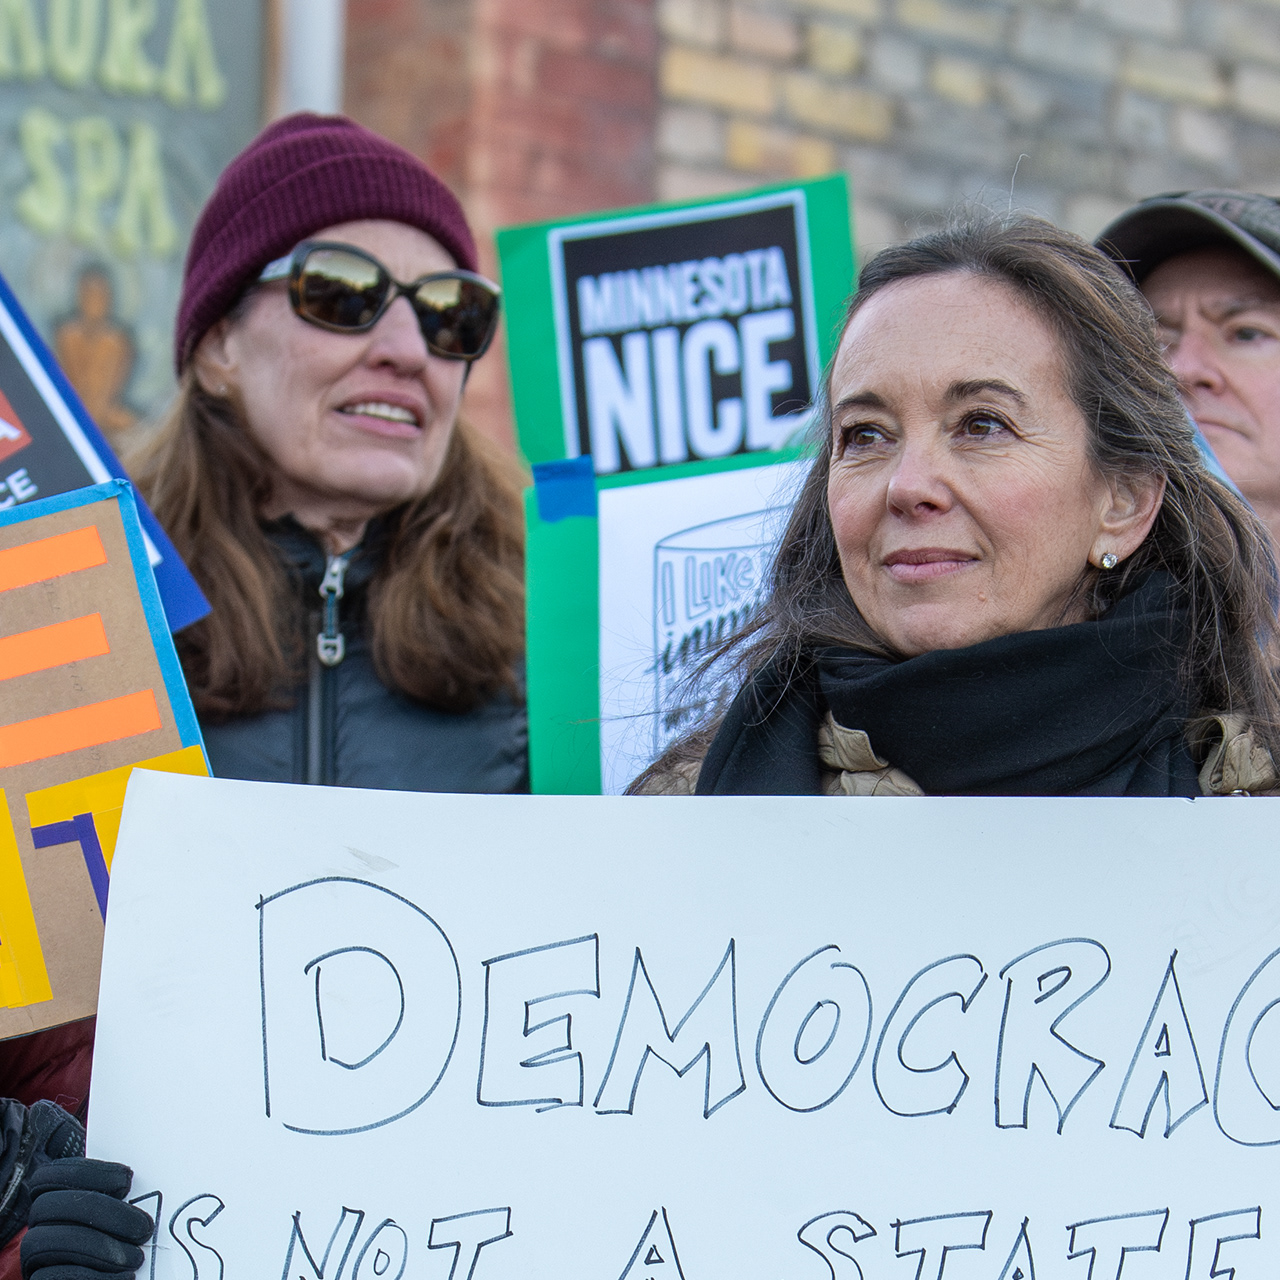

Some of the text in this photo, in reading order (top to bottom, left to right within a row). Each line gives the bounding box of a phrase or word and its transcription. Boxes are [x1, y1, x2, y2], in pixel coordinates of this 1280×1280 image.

[17, 108, 177, 257] SPA
[577, 246, 793, 338] MINNESOTA
[582, 308, 810, 476] NICE
